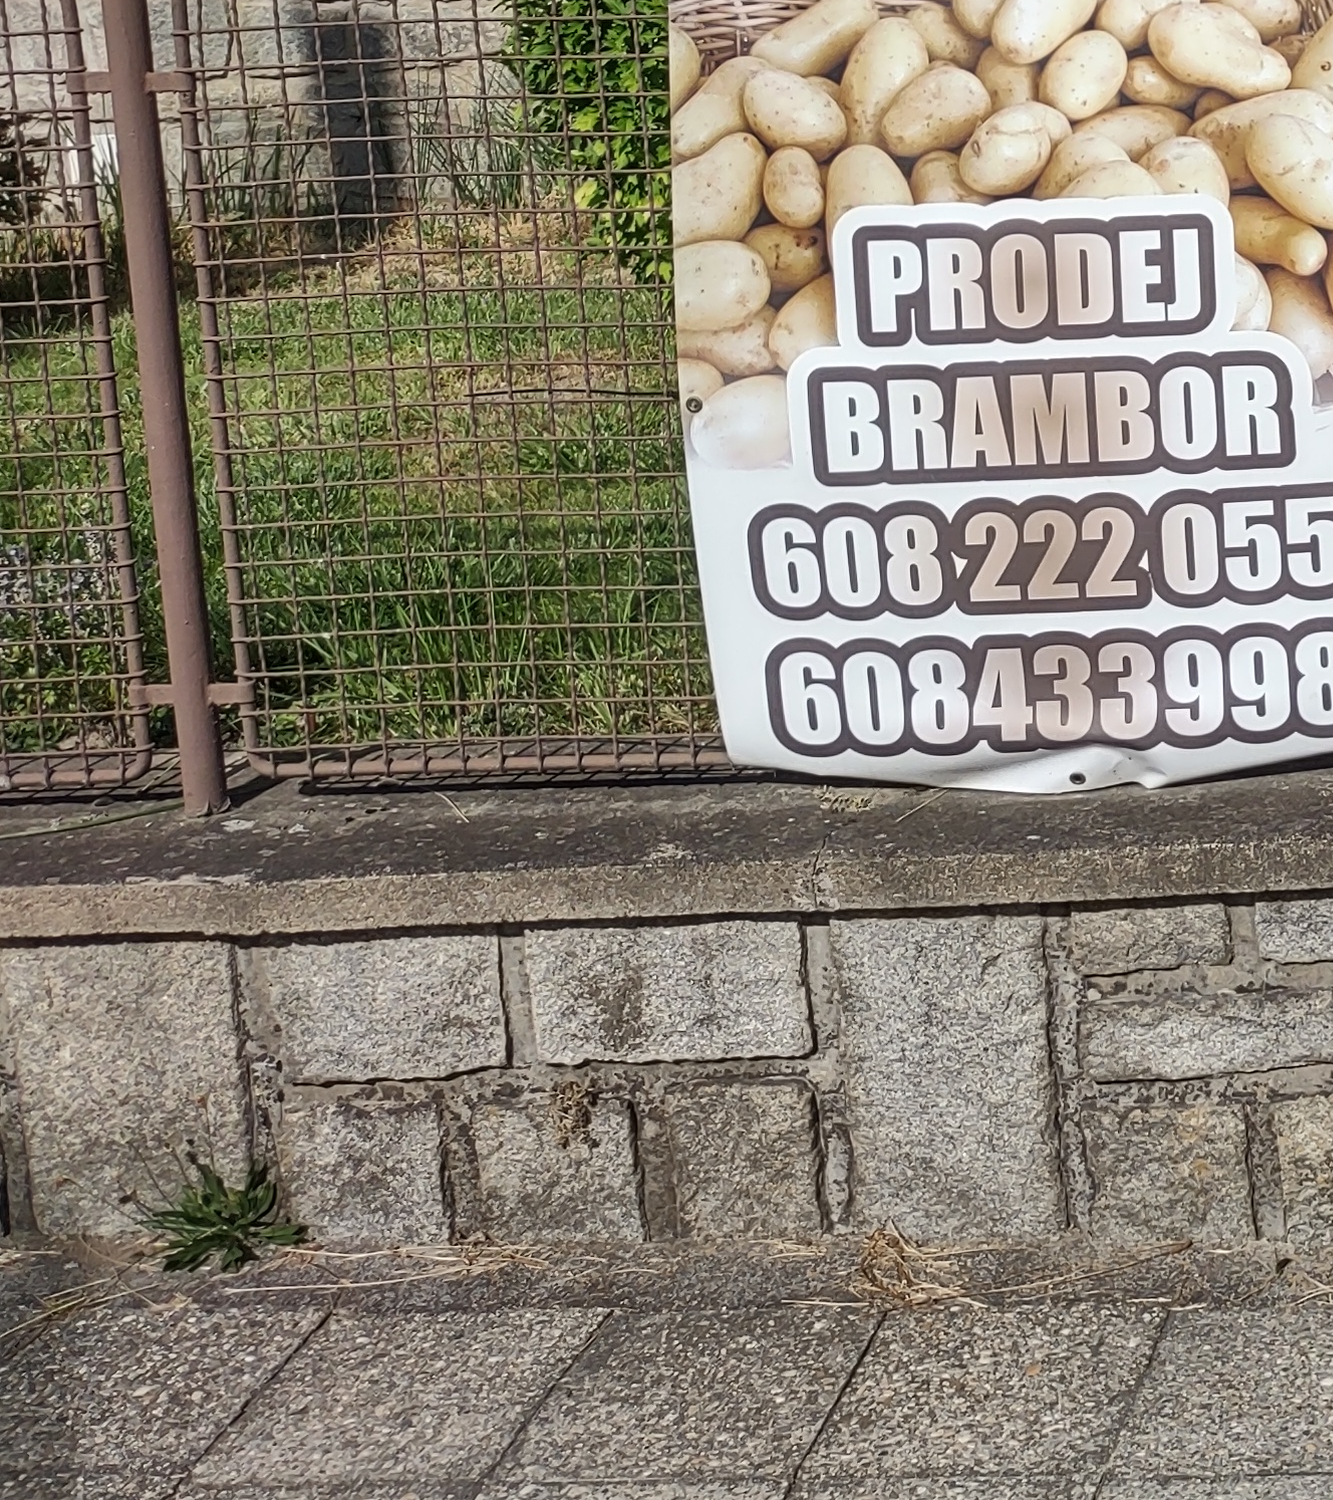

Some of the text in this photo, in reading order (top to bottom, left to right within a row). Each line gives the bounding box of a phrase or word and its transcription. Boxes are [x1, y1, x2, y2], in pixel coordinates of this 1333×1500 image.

[863, 225, 1202, 335] PRODEJ
[819, 363, 1284, 475] BRAMBOR
[759, 512, 945, 610] 608
[962, 505, 1140, 603] 222
